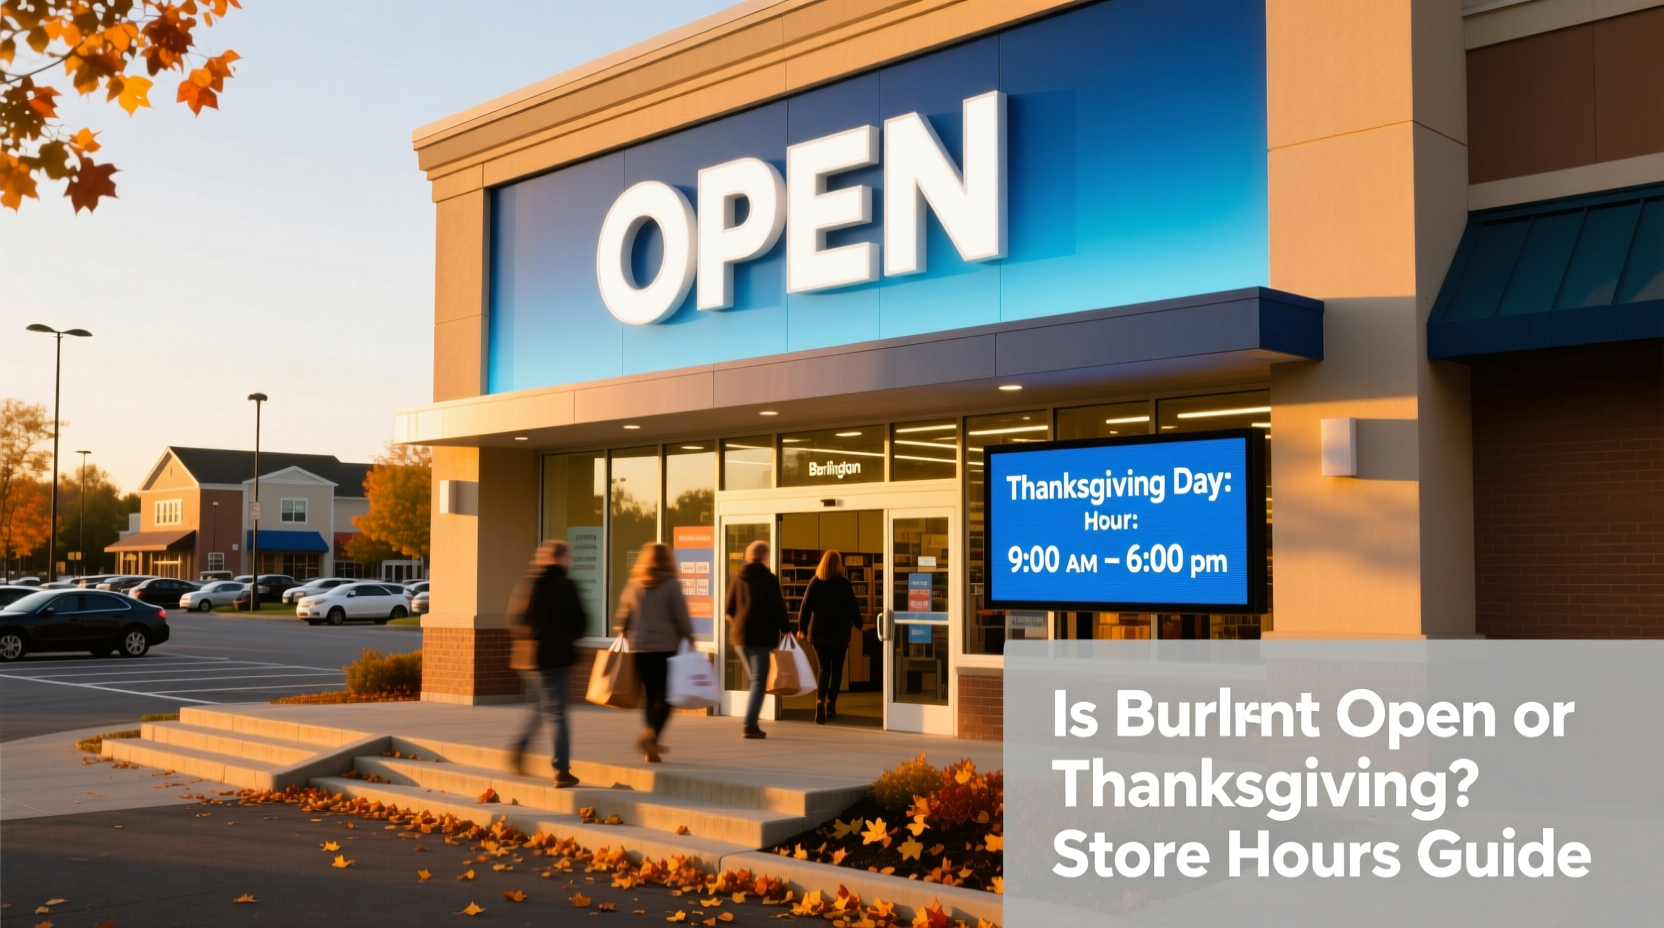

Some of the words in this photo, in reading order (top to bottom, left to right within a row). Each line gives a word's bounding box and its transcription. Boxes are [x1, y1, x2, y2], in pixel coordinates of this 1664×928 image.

[596, 90, 1008, 326] OPEN
[1006, 469, 1166, 505] Thanksgiving
[1173, 467, 1232, 502] Day:
[1084, 511, 1138, 531] Hour:
[1008, 545, 1060, 573] 9:00
[1066, 554, 1098, 573] AM
[1126, 544, 1183, 573] 6:00
[1190, 554, 1228, 578] pm
